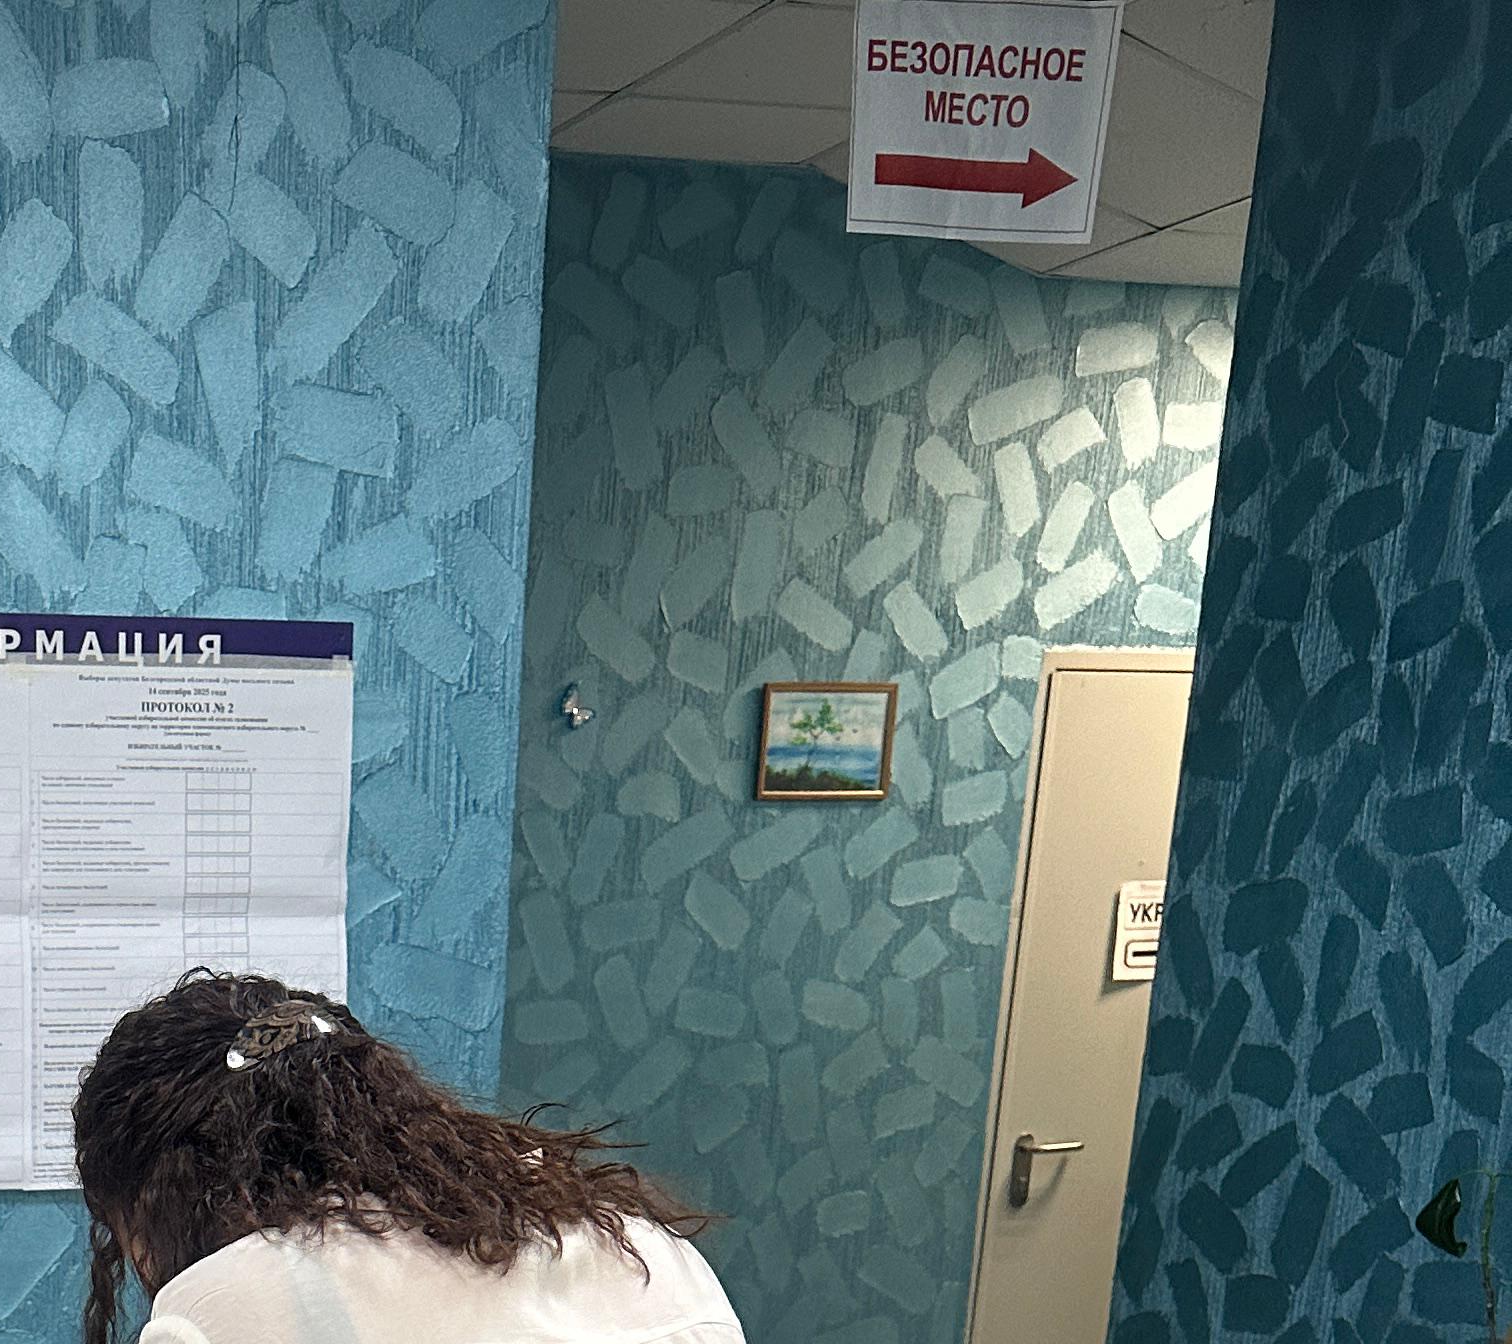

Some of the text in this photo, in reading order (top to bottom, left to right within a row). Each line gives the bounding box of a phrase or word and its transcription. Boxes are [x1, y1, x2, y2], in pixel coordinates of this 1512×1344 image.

[867, 38, 1086, 82] БЕЗОПАСНОЕ
[924, 90, 1030, 128] МЕСТО
[141, 701, 234, 714] ПРОТОКОЛ № 2
